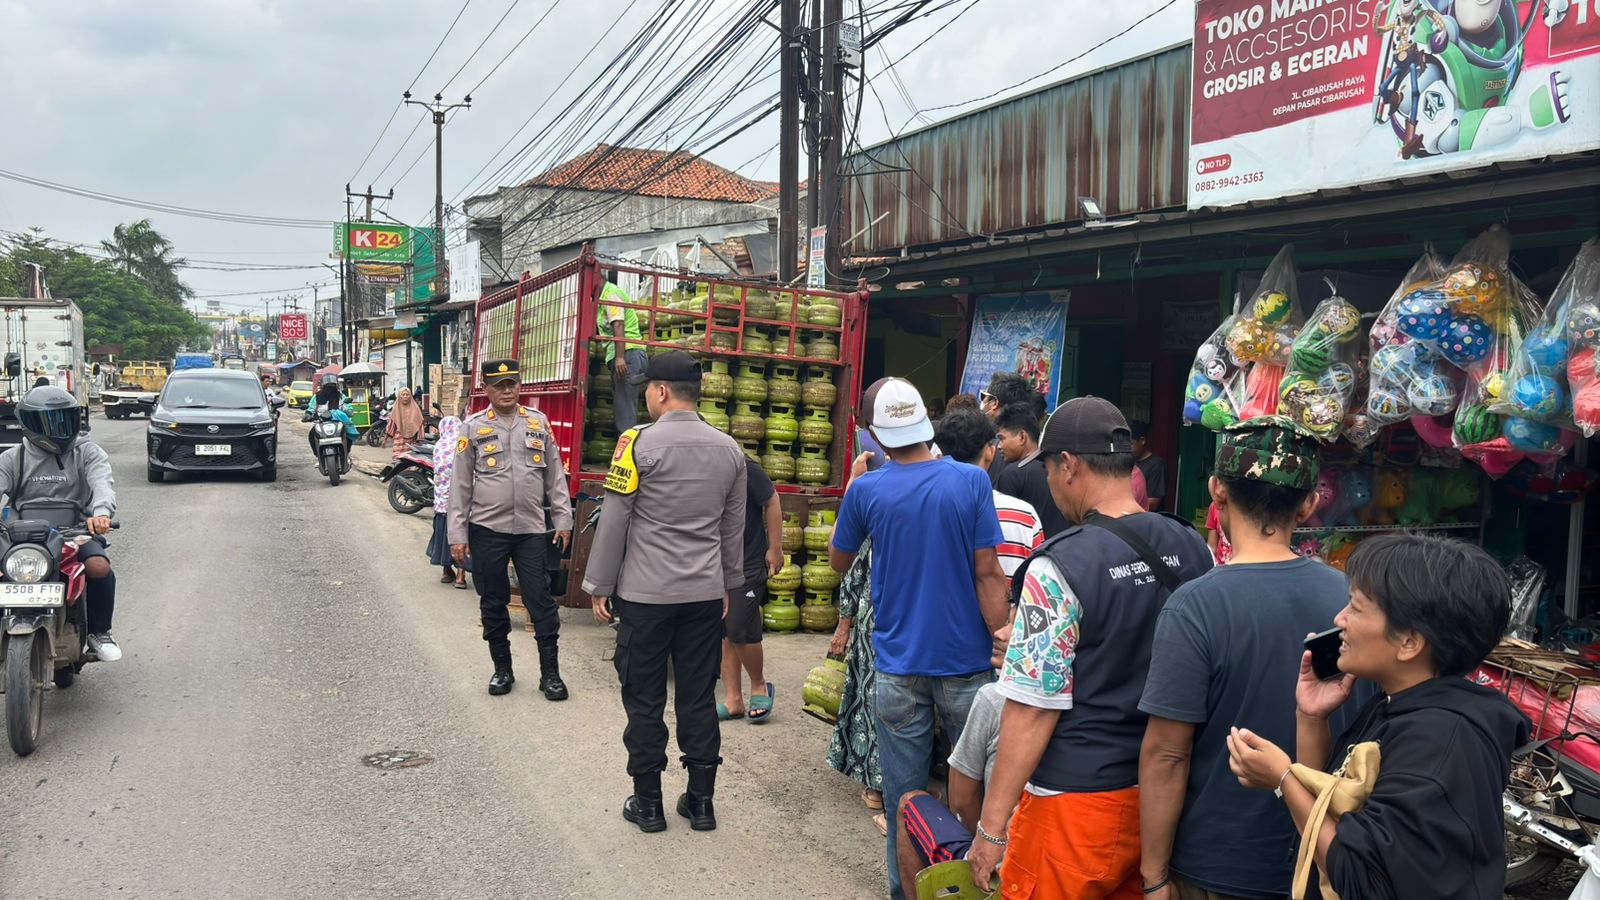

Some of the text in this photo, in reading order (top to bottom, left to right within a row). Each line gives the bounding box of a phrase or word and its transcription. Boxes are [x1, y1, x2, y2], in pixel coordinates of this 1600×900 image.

[1205, 5, 1264, 43] TOKO
[1203, 0, 1371, 74] & ACCSESORIS
[1203, 35, 1368, 99] GROSIR & ECERAN
[1291, 75, 1366, 101] JL. CIBARUSAH RAYA
[1273, 87, 1365, 116] DEPAN PASAR CIBARUSAH
[1205, 160, 1215, 169] NO
[1195, 171, 1264, 192] 0882-9942-5363
[282, 320, 304, 328] NICE
[1109, 564, 1131, 579] DINAS
[5, 585, 34, 594] 5508
